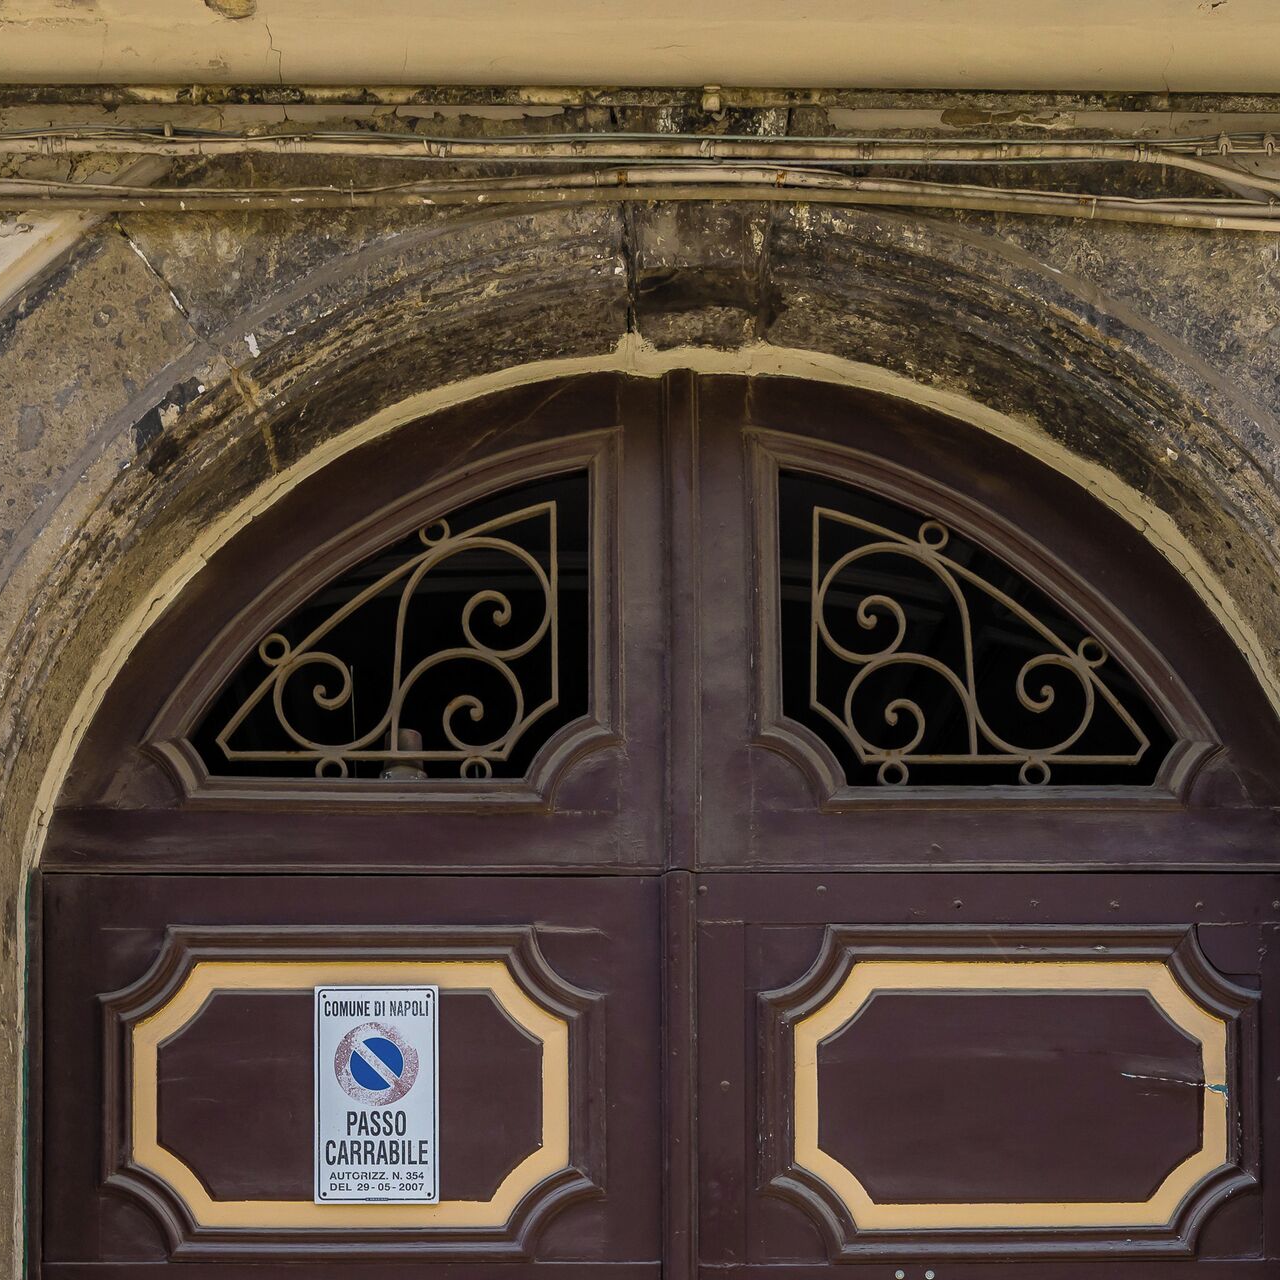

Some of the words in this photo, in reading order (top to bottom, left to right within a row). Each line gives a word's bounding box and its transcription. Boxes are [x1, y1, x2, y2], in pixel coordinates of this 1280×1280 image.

[324, 1000, 370, 1017] COMUNE
[374, 1001, 385, 1017] DI
[389, 1000, 429, 1017] NAPOLI
[346, 1110, 407, 1136] PASSO
[325, 1139, 429, 1166] CARRABILE
[329, 1171, 389, 1181] AUTORIZZ.
[392, 1171, 403, 1181] N.
[405, 1171, 425, 1181] 354
[329, 1182, 352, 1192] DEL
